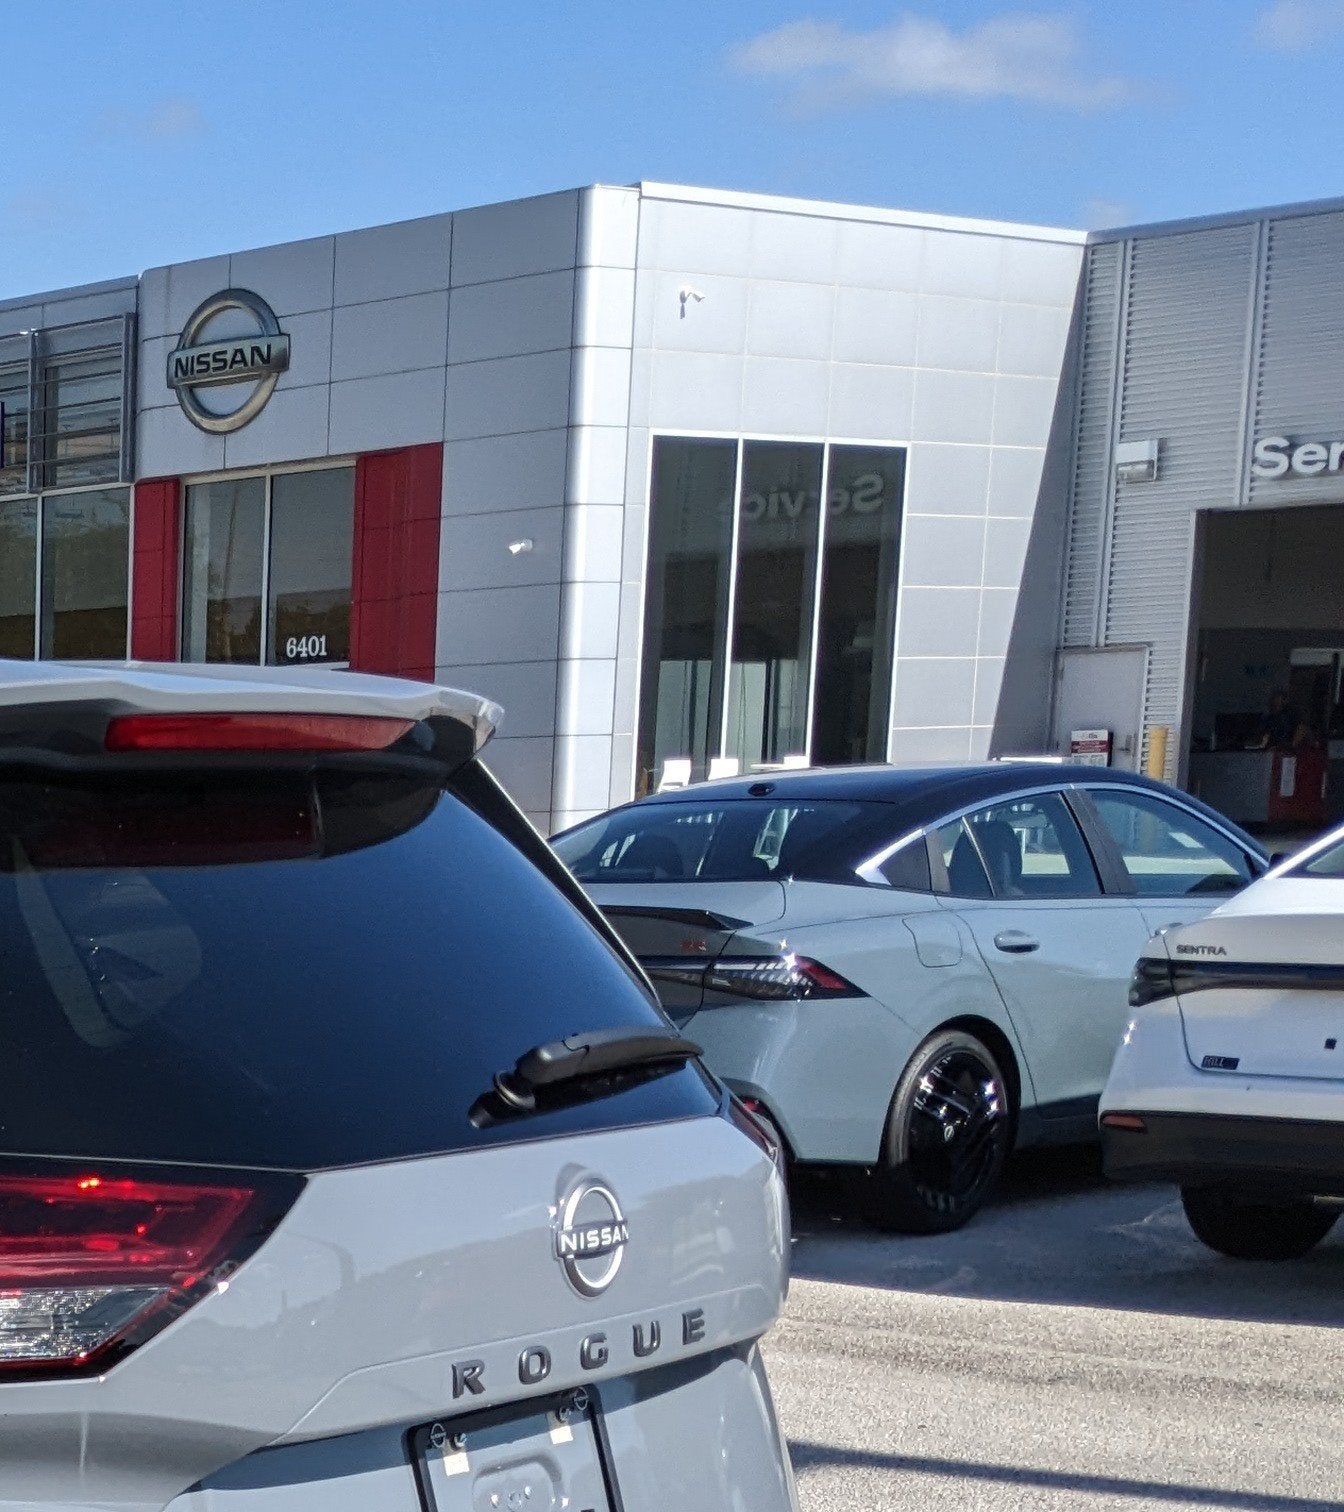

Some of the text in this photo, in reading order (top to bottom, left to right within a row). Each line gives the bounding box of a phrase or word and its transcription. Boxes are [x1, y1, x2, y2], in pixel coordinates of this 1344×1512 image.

[174, 343, 272, 378] NISSAN
[286, 634, 328, 658] 6401
[1176, 944, 1227, 956] SENTRA
[560, 1224, 630, 1253] NISSAN
[451, 1308, 706, 1400] ROGUE
